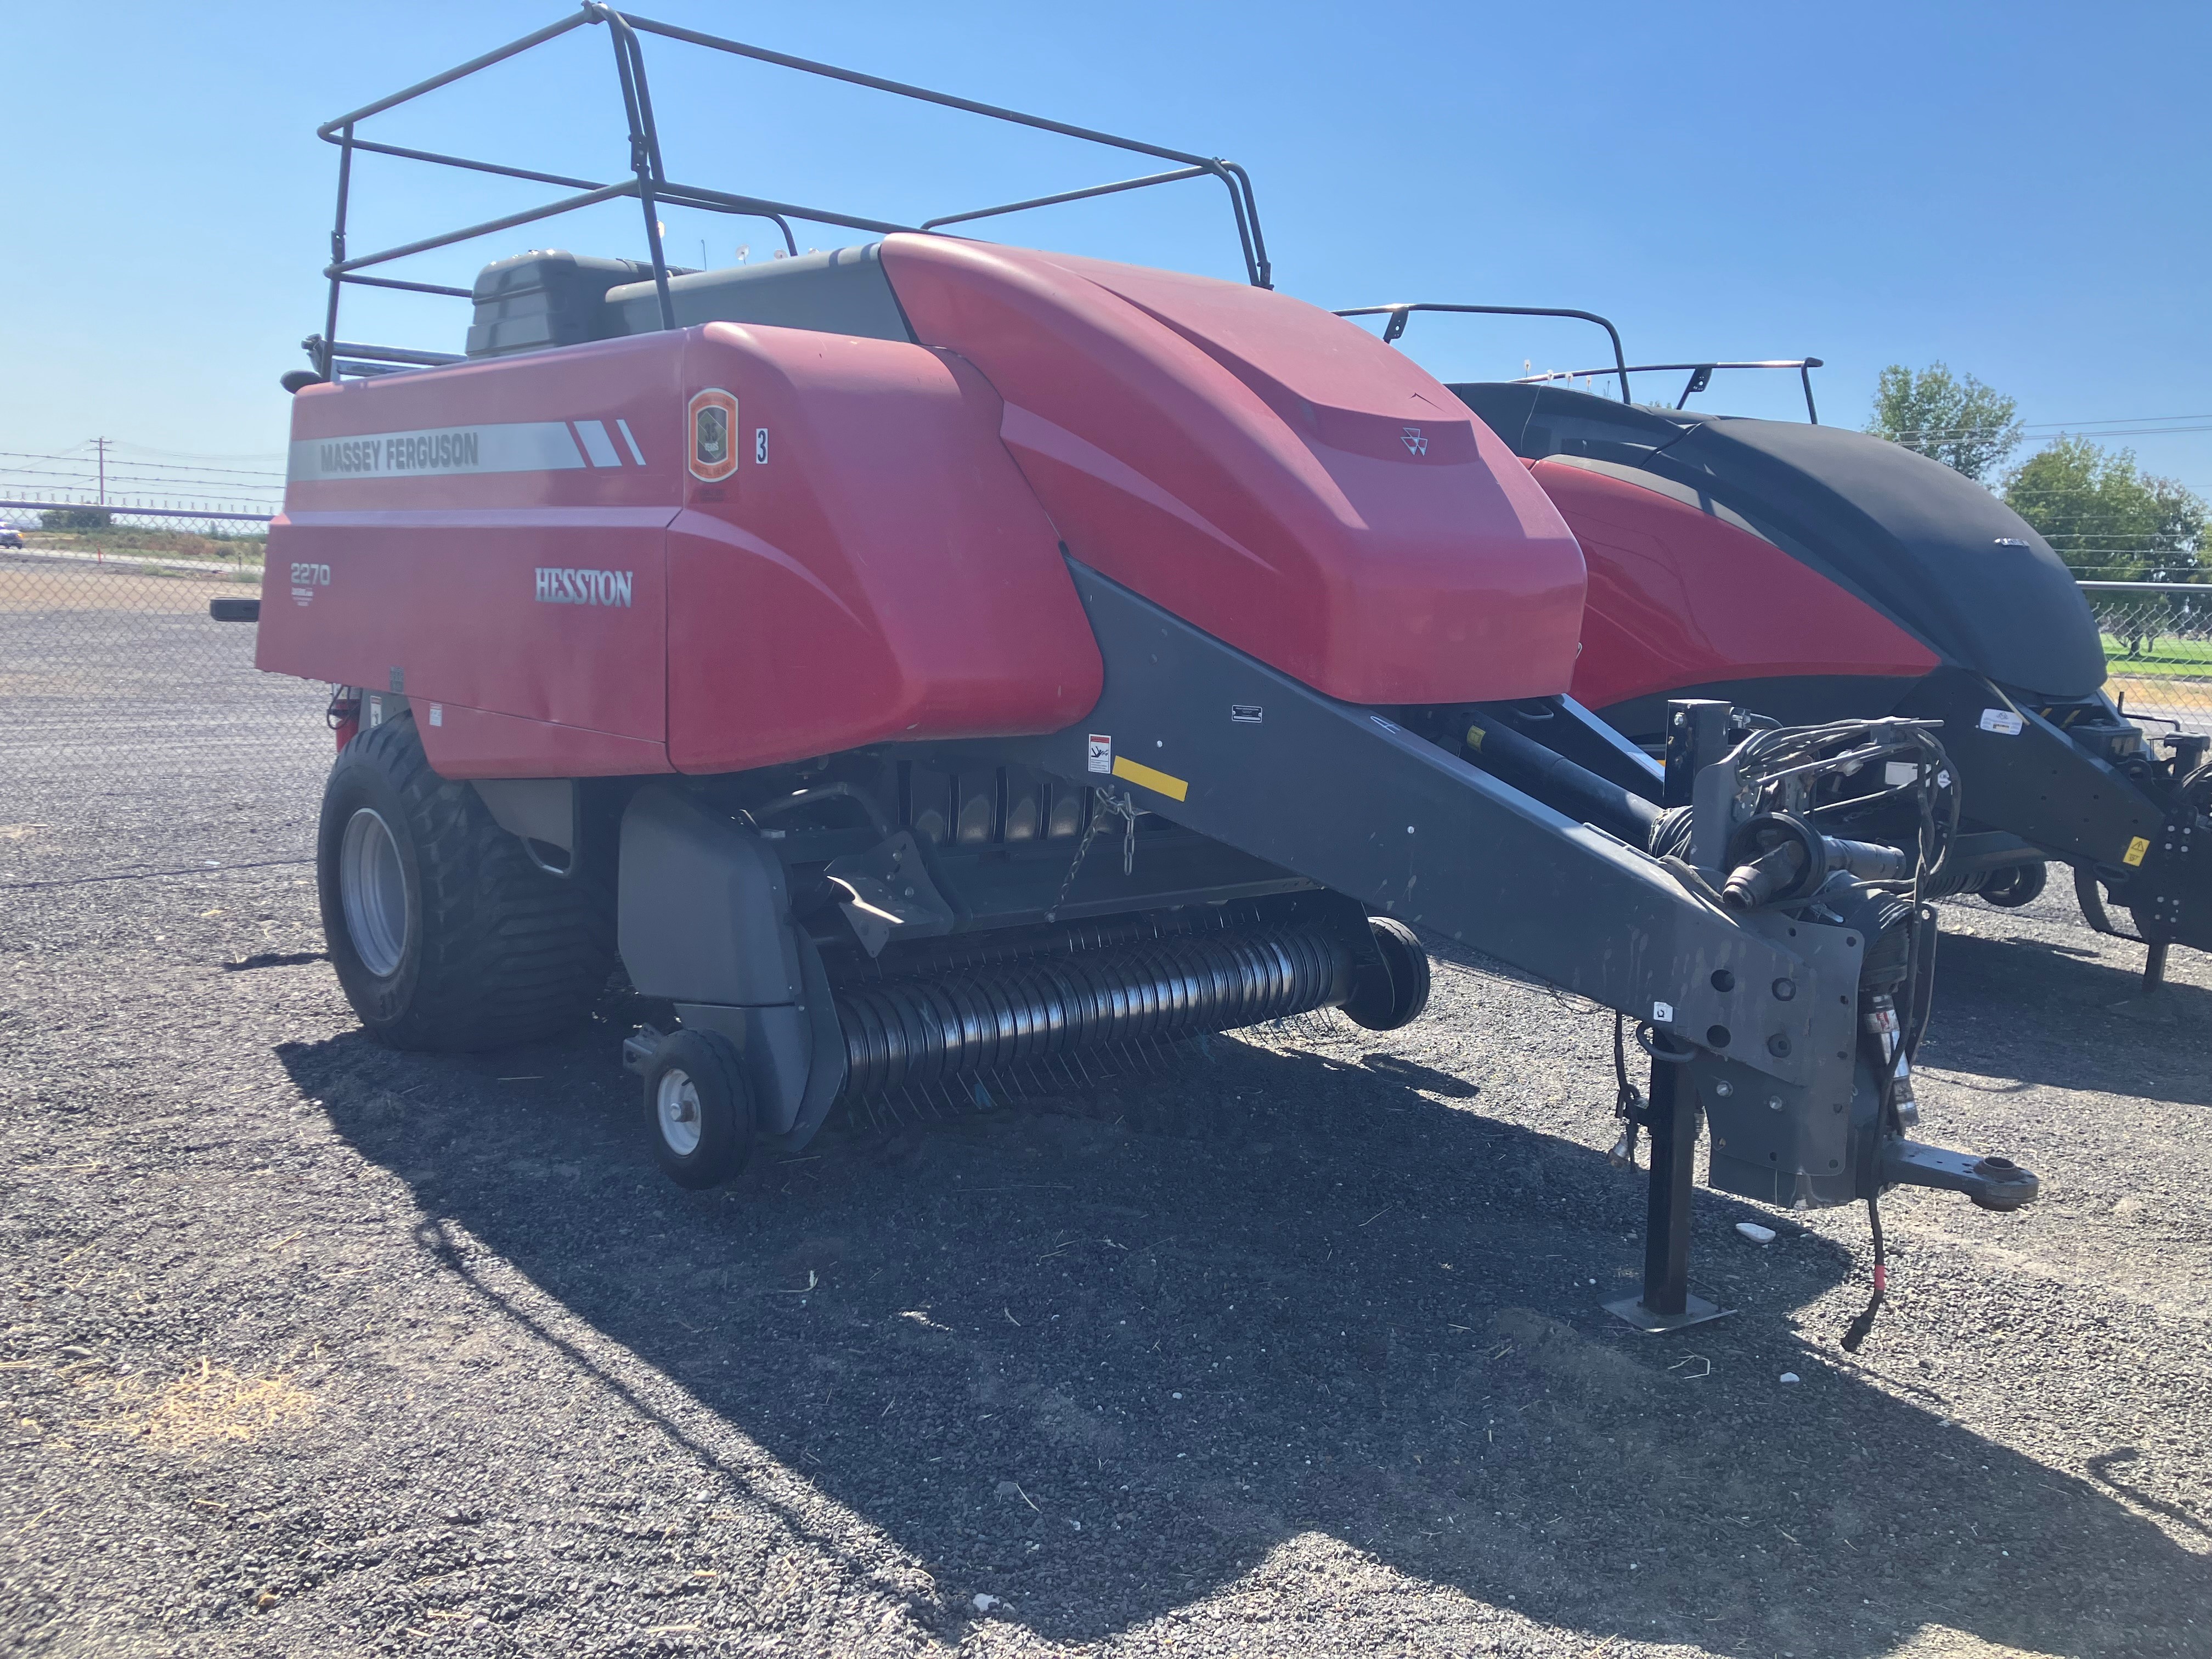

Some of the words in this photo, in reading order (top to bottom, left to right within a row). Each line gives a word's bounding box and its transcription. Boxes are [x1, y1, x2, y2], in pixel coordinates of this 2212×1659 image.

[320, 440, 381, 473] MASSEY
[386, 432, 479, 470] FERGUSON
[757, 430, 766, 462] 3
[290, 562, 330, 585] 2270
[534, 567, 633, 608] HESSTON
